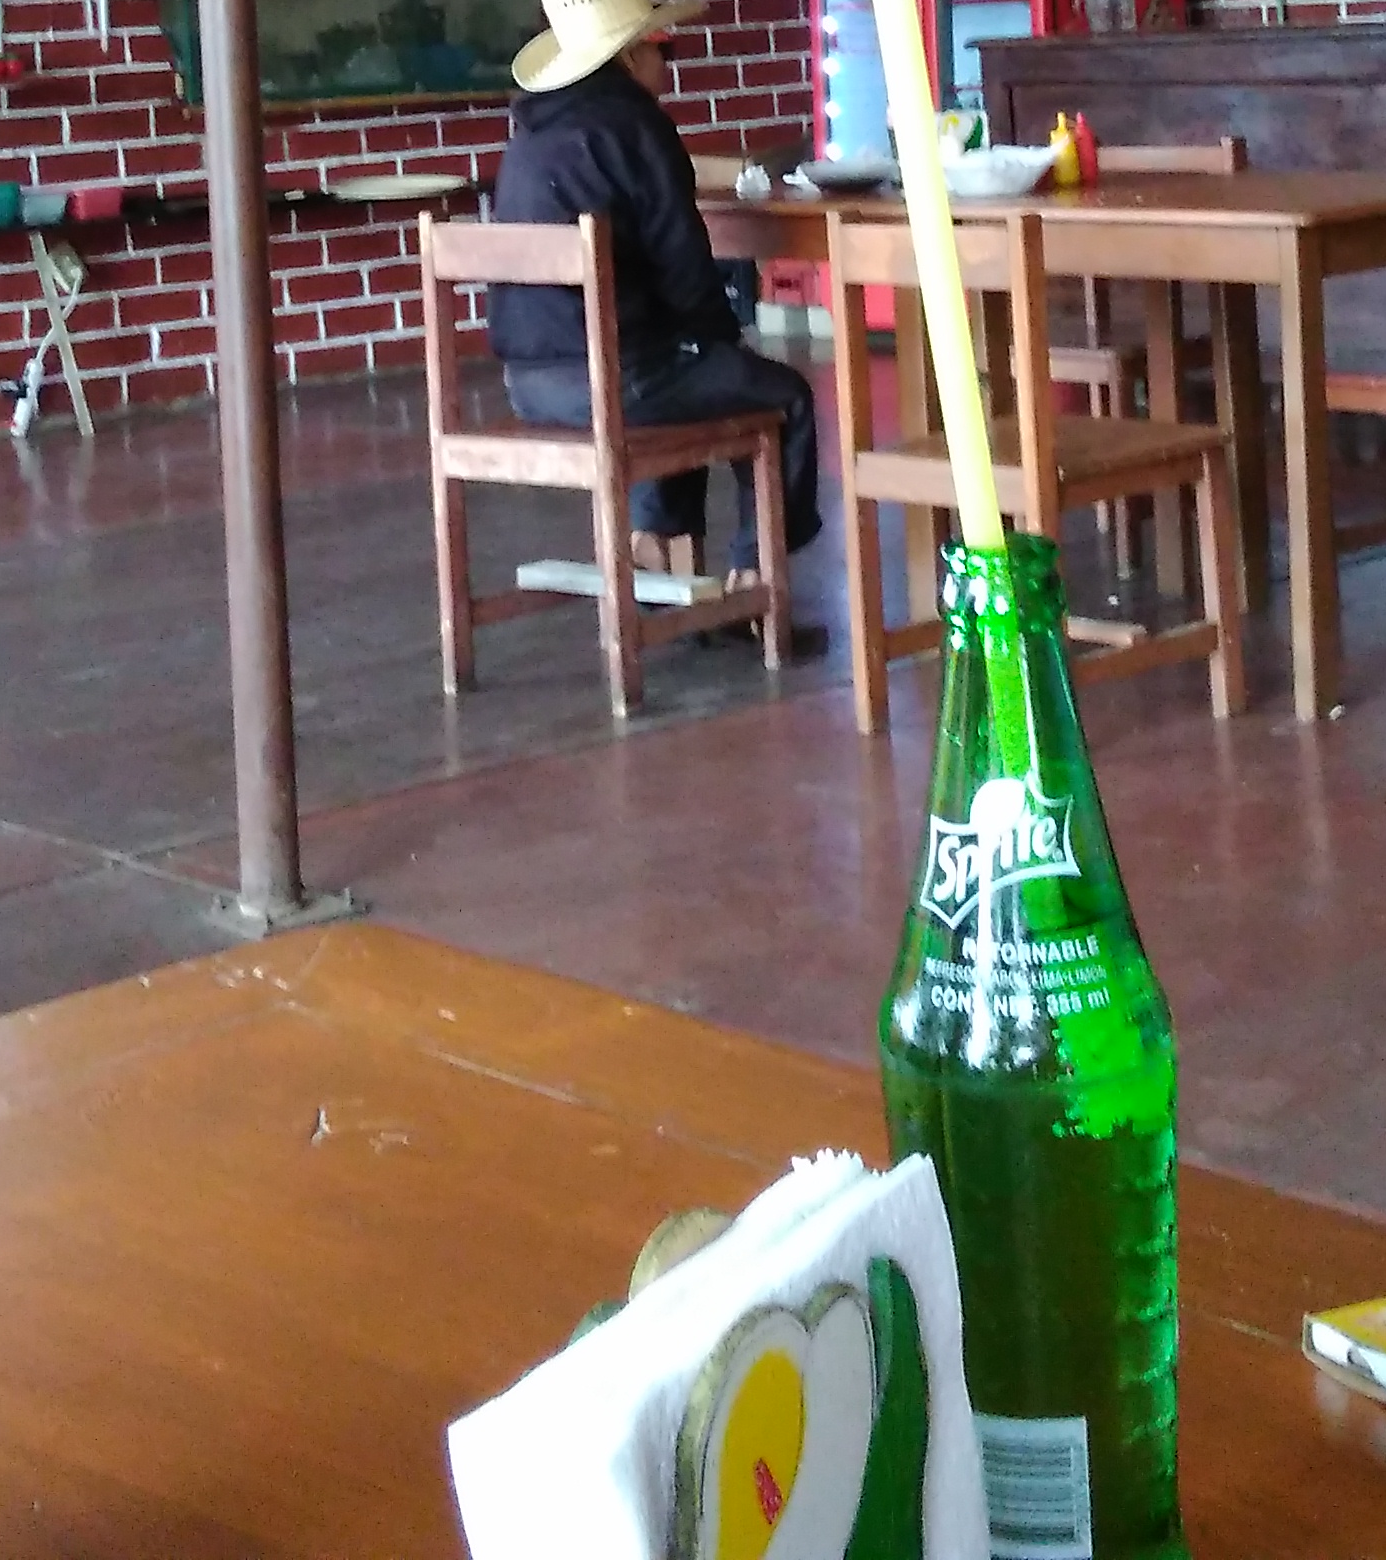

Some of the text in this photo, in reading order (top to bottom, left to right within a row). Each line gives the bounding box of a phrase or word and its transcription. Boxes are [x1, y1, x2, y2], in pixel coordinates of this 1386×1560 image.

[932, 806, 1059, 903] Sprite
[963, 934, 1101, 965] RTORNABLE
[1088, 986, 1110, 1009] ml
